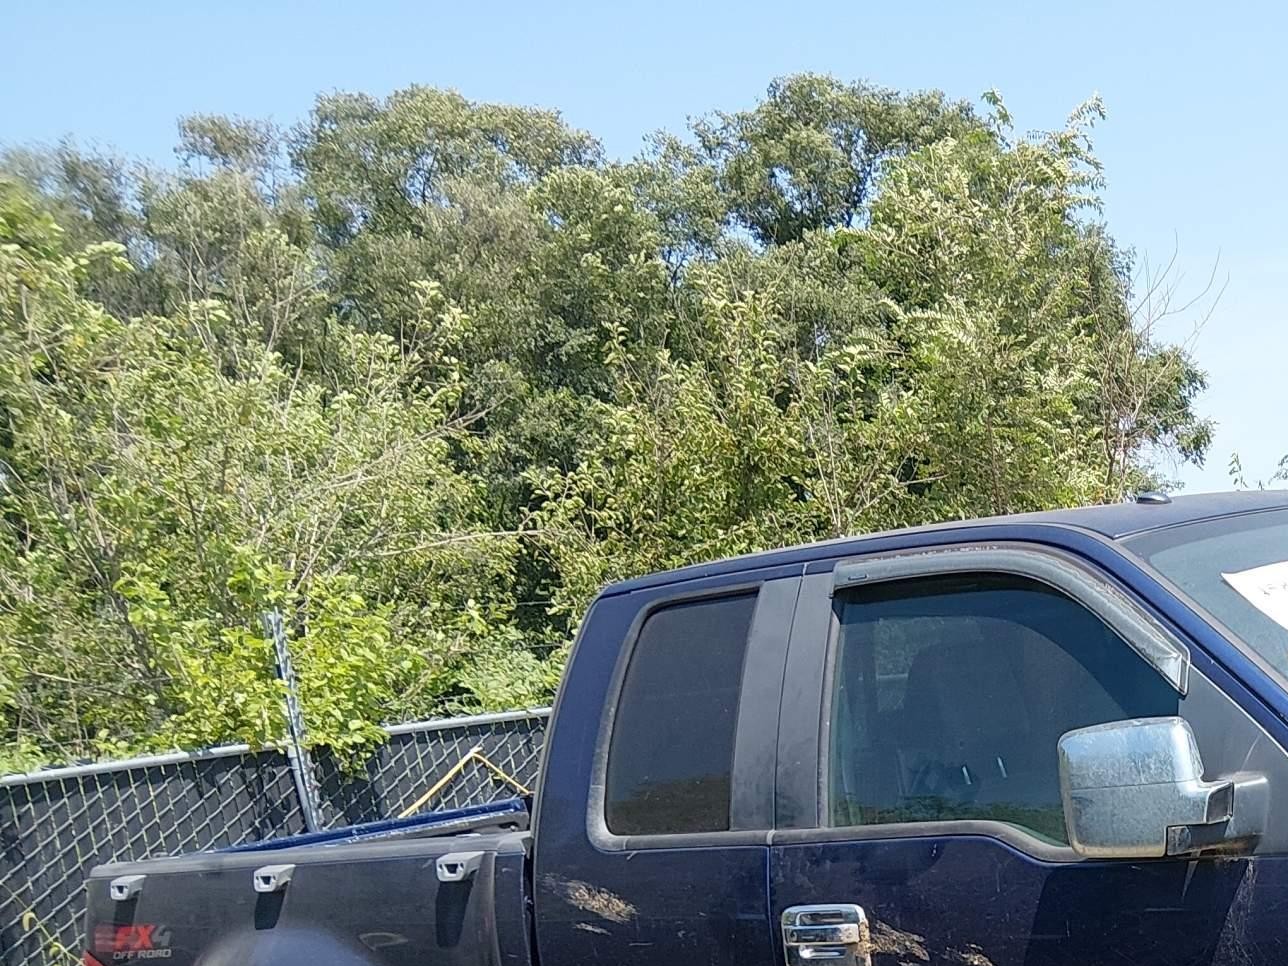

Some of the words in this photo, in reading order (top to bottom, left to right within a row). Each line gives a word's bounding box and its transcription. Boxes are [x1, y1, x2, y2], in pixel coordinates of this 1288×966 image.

[113, 925, 173, 951] FX4
[113, 951, 136, 960] OFF
[137, 949, 172, 959] ROAD
